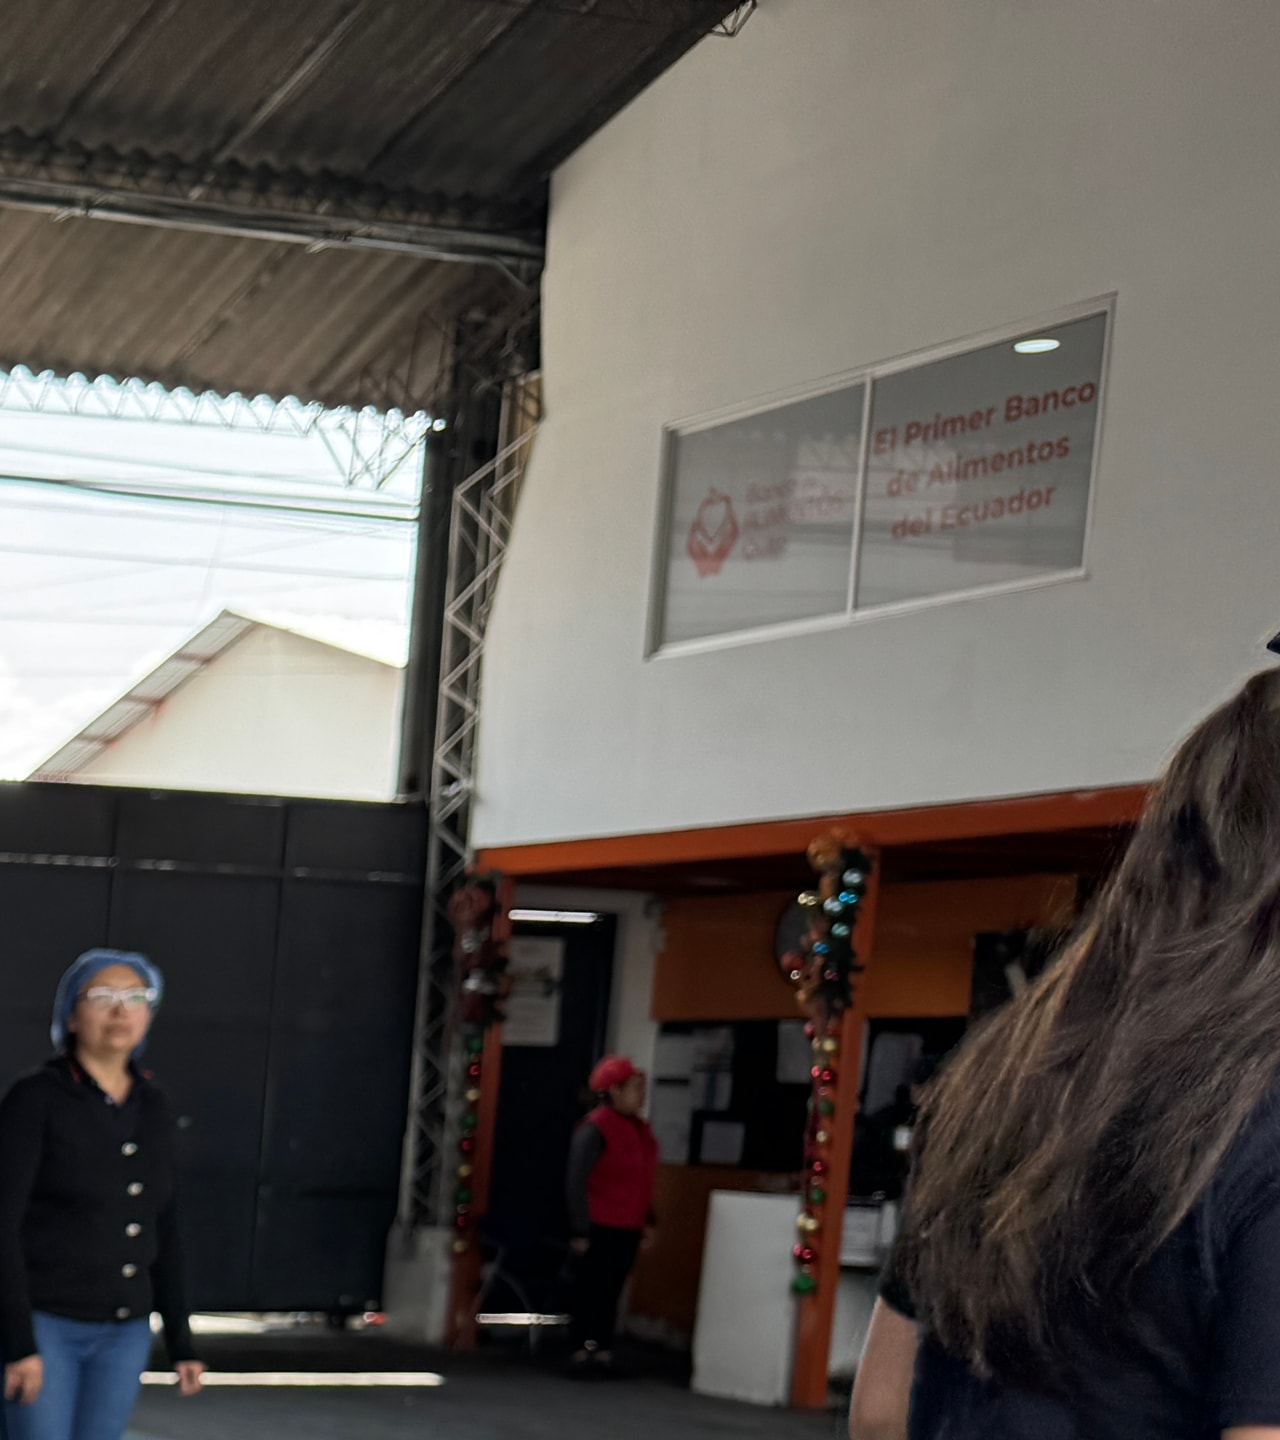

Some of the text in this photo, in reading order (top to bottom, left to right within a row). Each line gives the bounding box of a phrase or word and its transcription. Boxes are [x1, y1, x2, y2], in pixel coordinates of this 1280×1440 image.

[873, 381, 1097, 455] El Primer Banco
[886, 470, 919, 498] de
[929, 435, 1071, 487] Alimentos
[891, 513, 931, 540] del
[941, 484, 1057, 531] Ecuador
